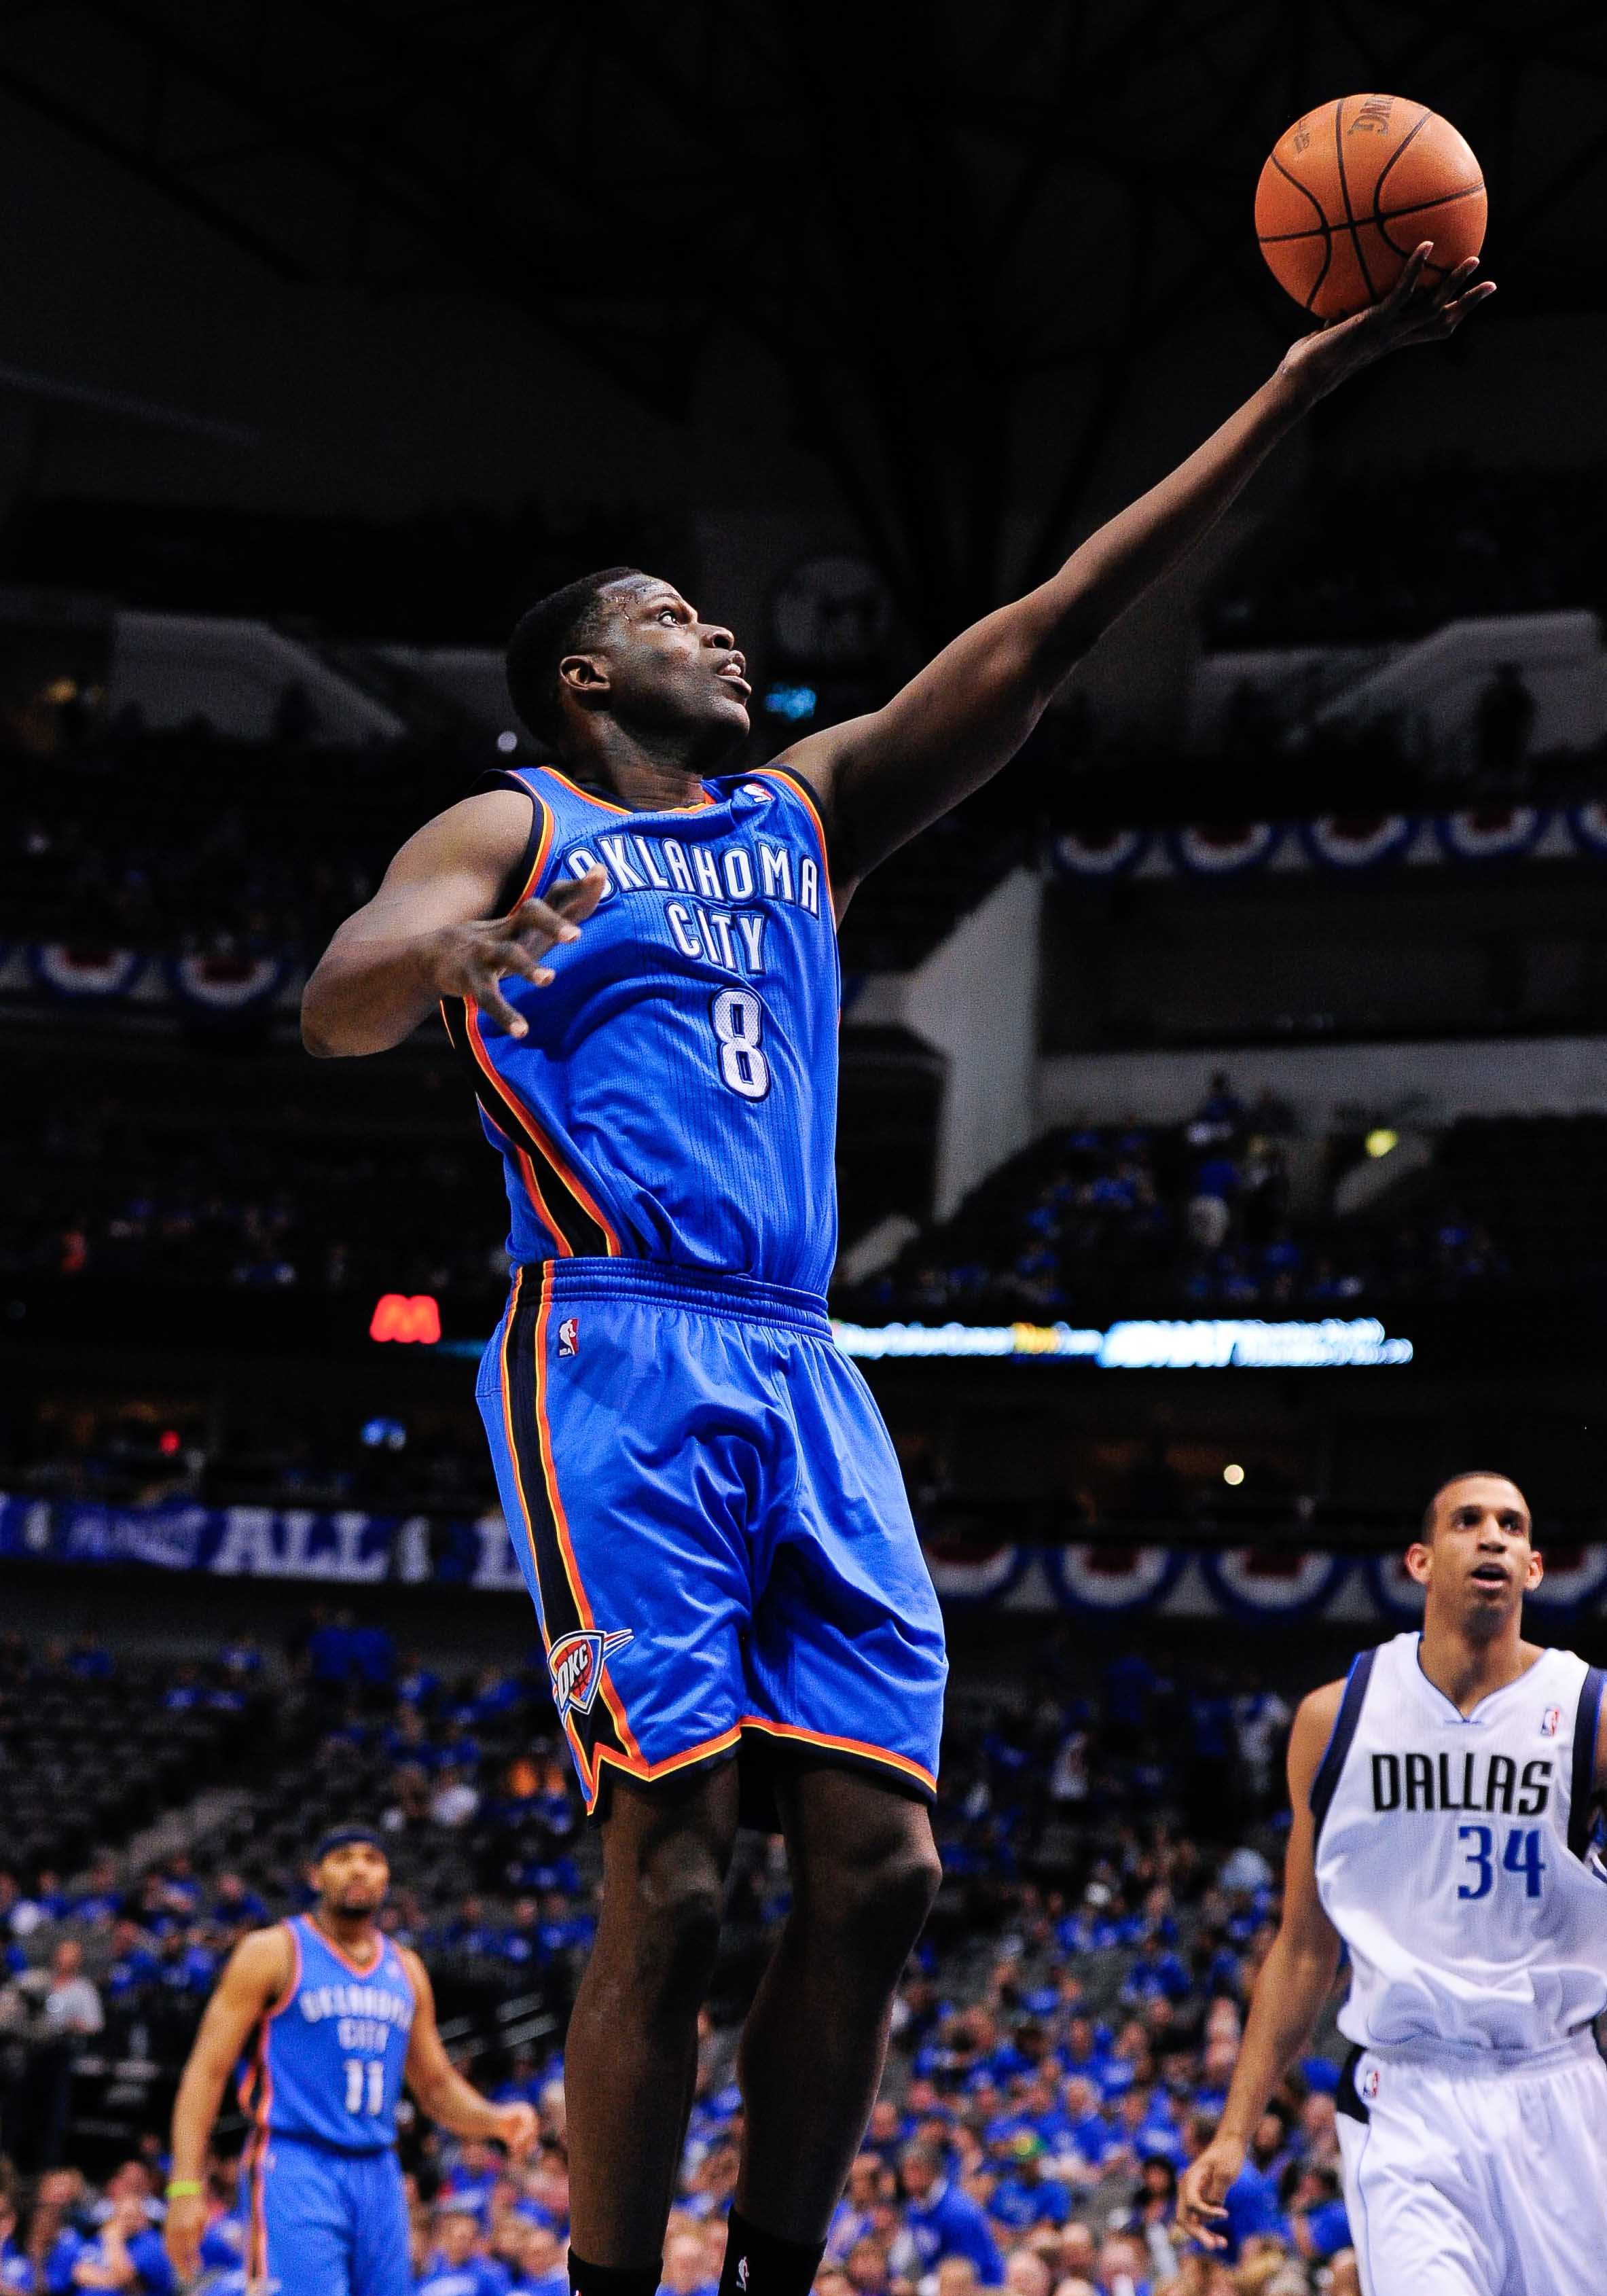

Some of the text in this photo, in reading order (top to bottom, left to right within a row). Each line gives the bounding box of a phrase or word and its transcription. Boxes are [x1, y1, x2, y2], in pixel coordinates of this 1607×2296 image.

[564, 833, 819, 920] OKLAHOMA
[664, 900, 766, 974] CITY
[709, 985, 772, 1103] 8
[557, 1644, 589, 1710] OKC
[1371, 1751, 1554, 1817] DALLAS
[1457, 1825, 1546, 1900] 34
[344, 2058, 384, 2115] 11
